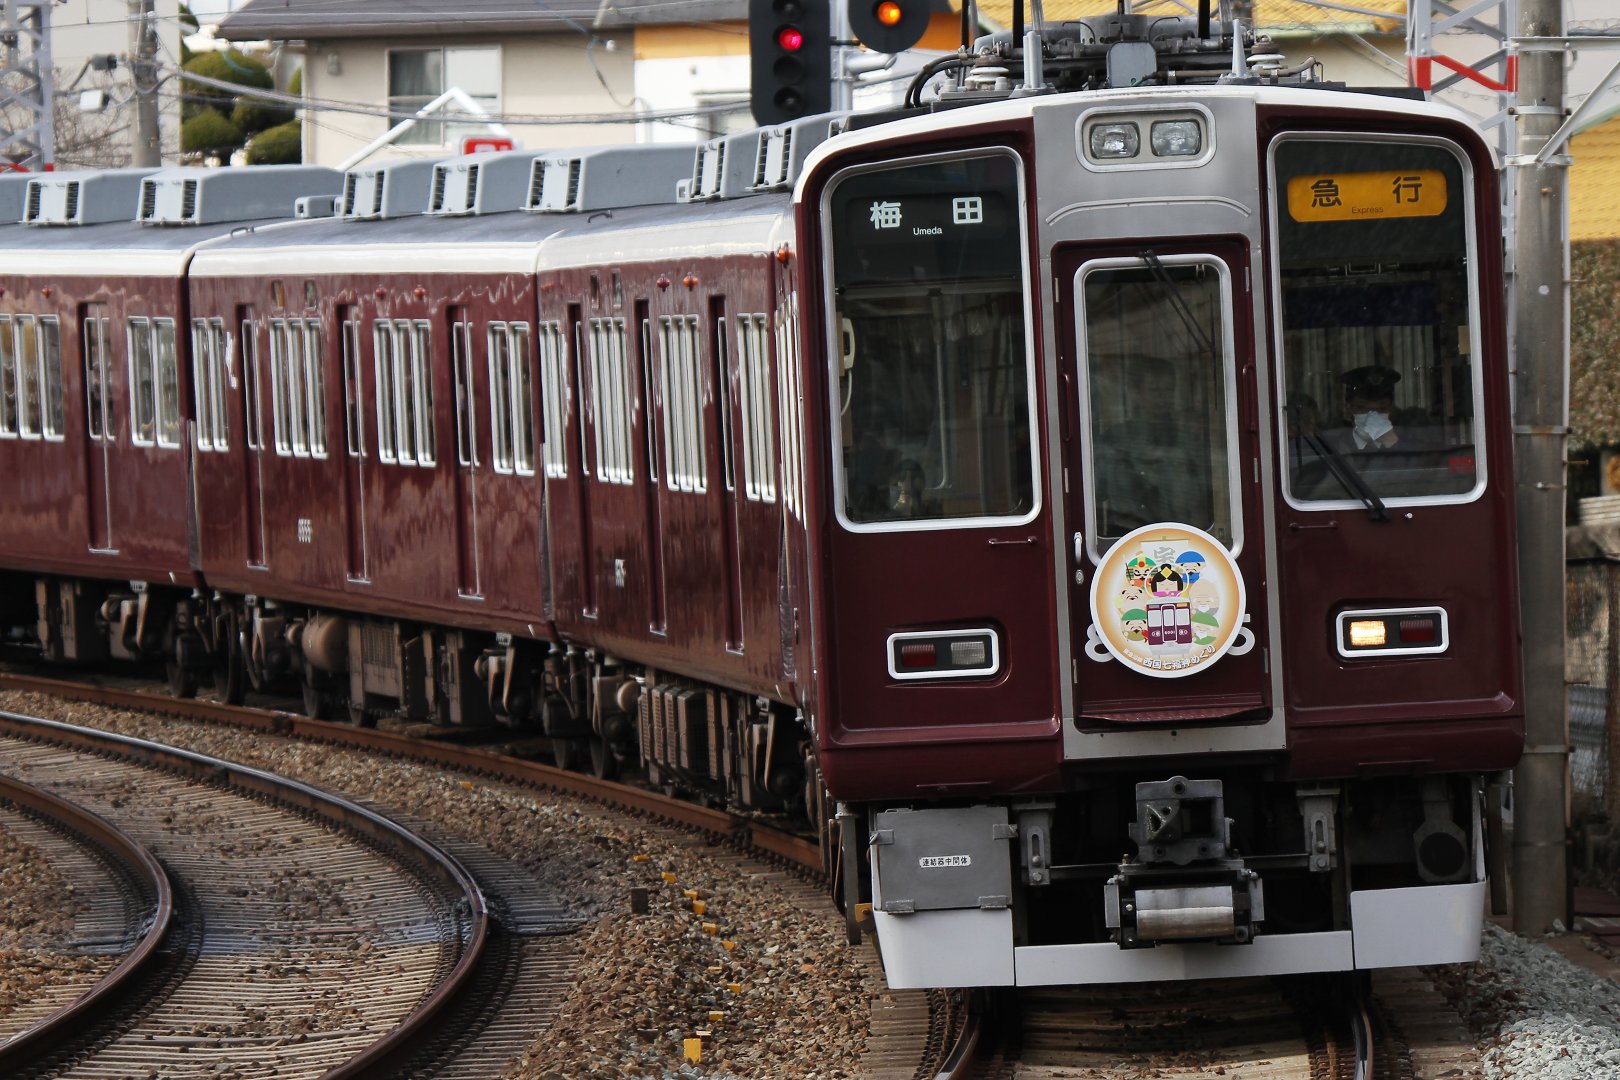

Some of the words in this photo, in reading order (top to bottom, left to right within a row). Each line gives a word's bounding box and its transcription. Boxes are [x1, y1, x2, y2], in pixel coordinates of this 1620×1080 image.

[1310, 175, 1423, 208] 急行
[869, 196, 983, 230] 梅田
[1351, 206, 1384, 215] Express
[912, 226, 943, 236] Umeda
